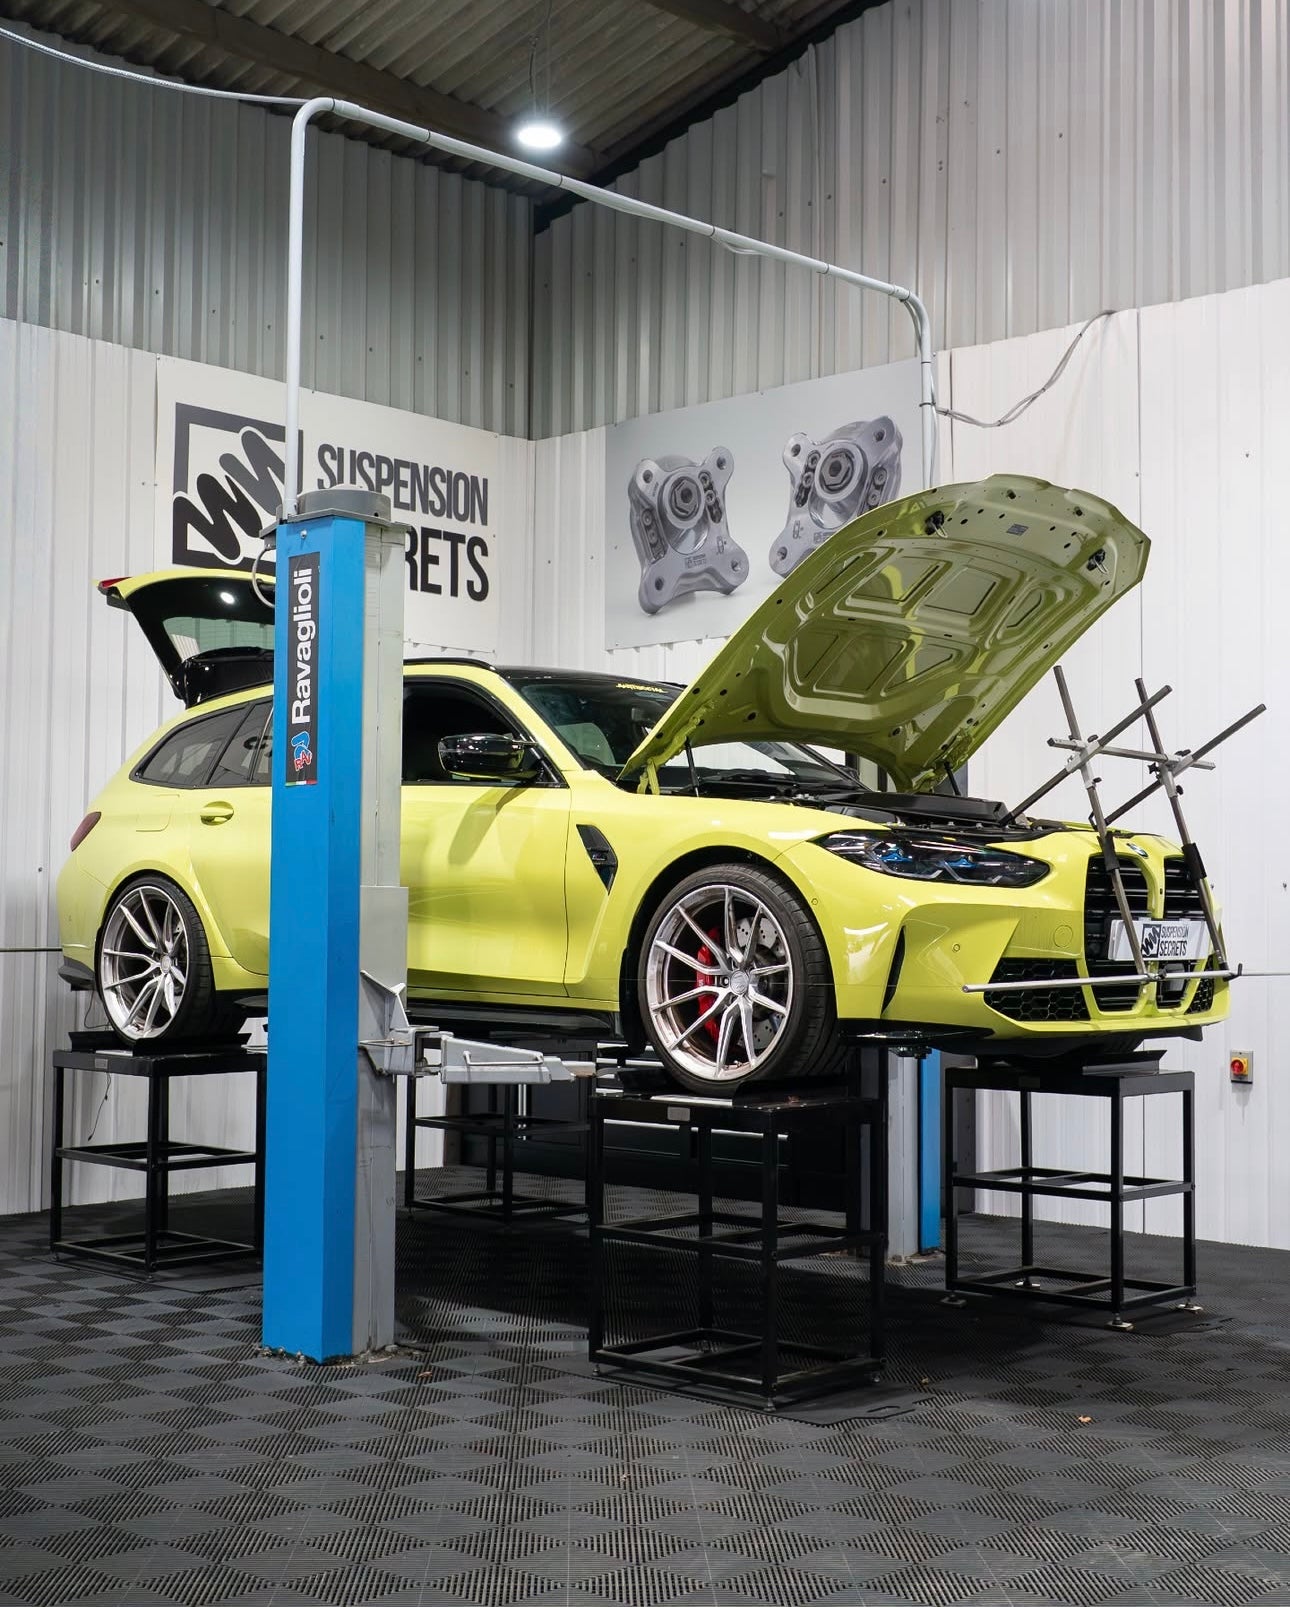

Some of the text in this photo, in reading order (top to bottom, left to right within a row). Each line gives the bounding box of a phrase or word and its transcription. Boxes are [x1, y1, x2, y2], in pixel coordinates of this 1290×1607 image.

[316, 443, 488, 526] SUSPENSION
[405, 525, 489, 602] RETS
[291, 568, 316, 724] Ravaglioli
[1159, 940, 1187, 956] SECRETS
